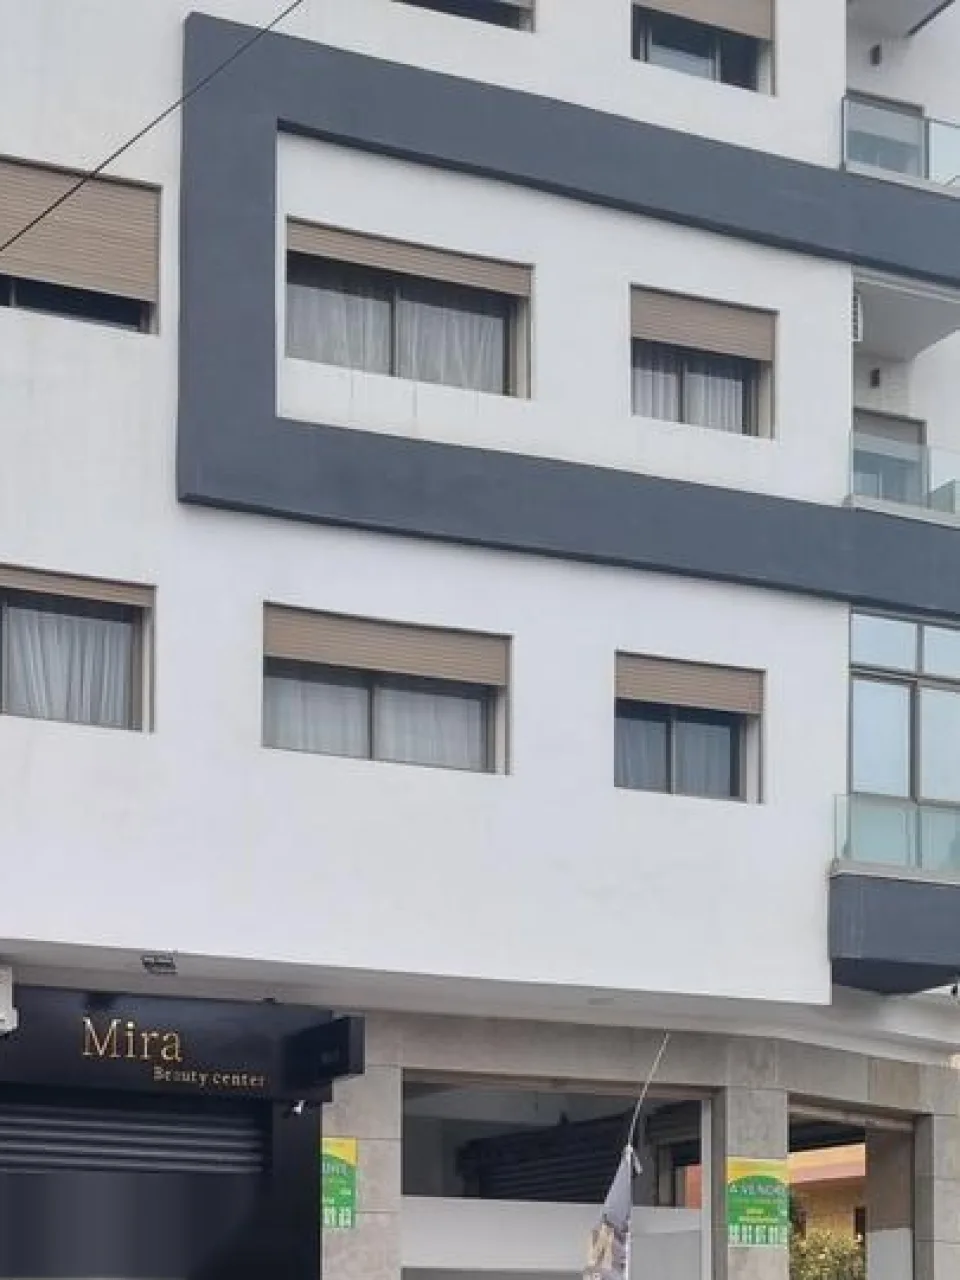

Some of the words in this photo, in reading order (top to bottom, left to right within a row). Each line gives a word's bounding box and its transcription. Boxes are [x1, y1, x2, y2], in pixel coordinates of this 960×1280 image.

[82, 1016, 183, 1063] Mira
[153, 1066, 207, 1088] Beauty
[212, 1071, 266, 1088] center
